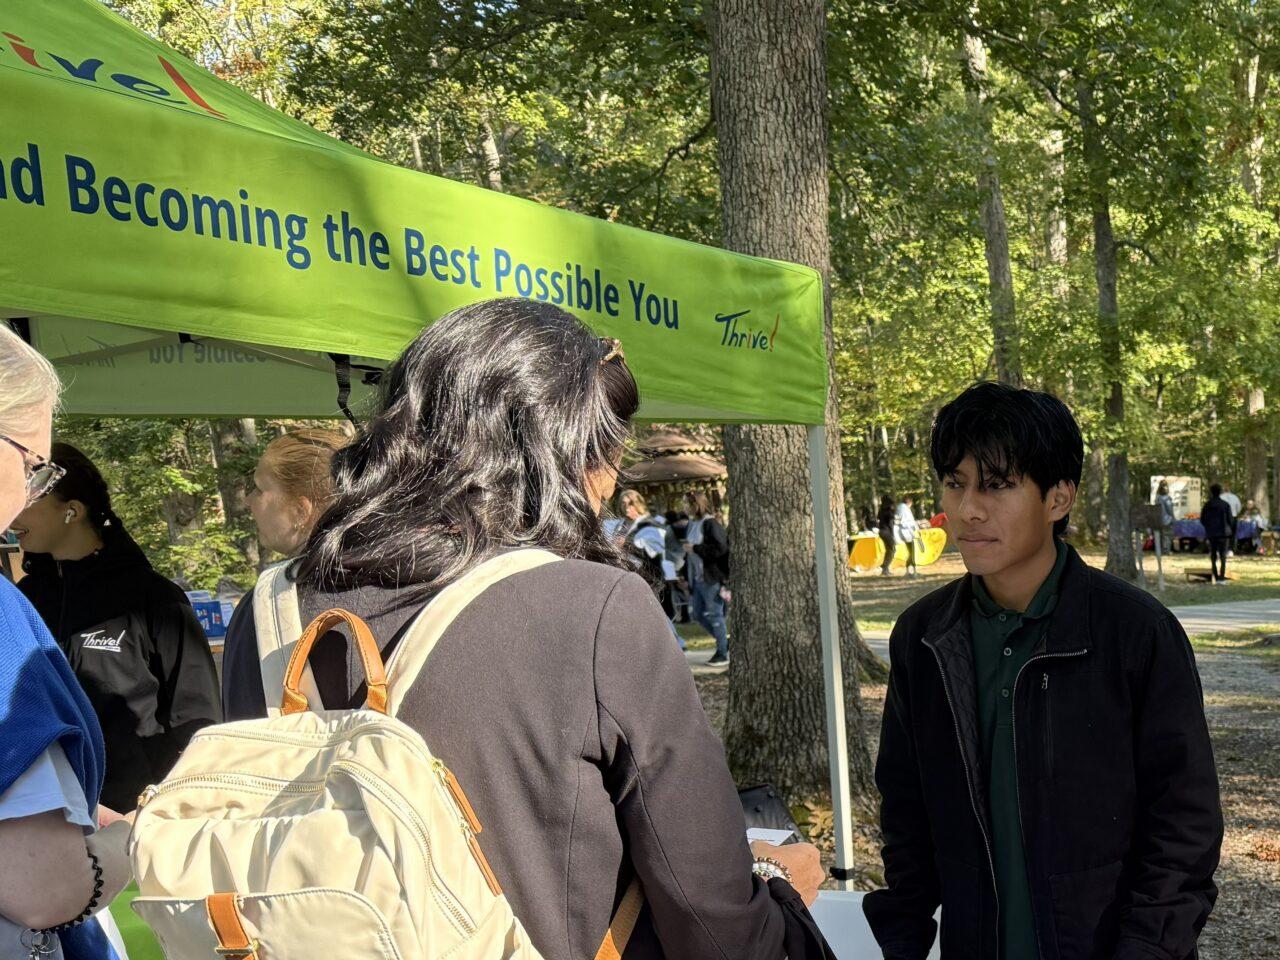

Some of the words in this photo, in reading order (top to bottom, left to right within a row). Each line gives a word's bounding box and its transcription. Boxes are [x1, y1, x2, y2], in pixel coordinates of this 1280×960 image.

[0, 31, 227, 119] ive!
[65, 154, 309, 269] Becoming
[322, 211, 391, 270] the
[404, 227, 482, 289] Best
[494, 247, 620, 317] Possible
[628, 279, 680, 330] You
[715, 309, 780, 353] Thrive!
[80, 629, 126, 647] Thrive!
